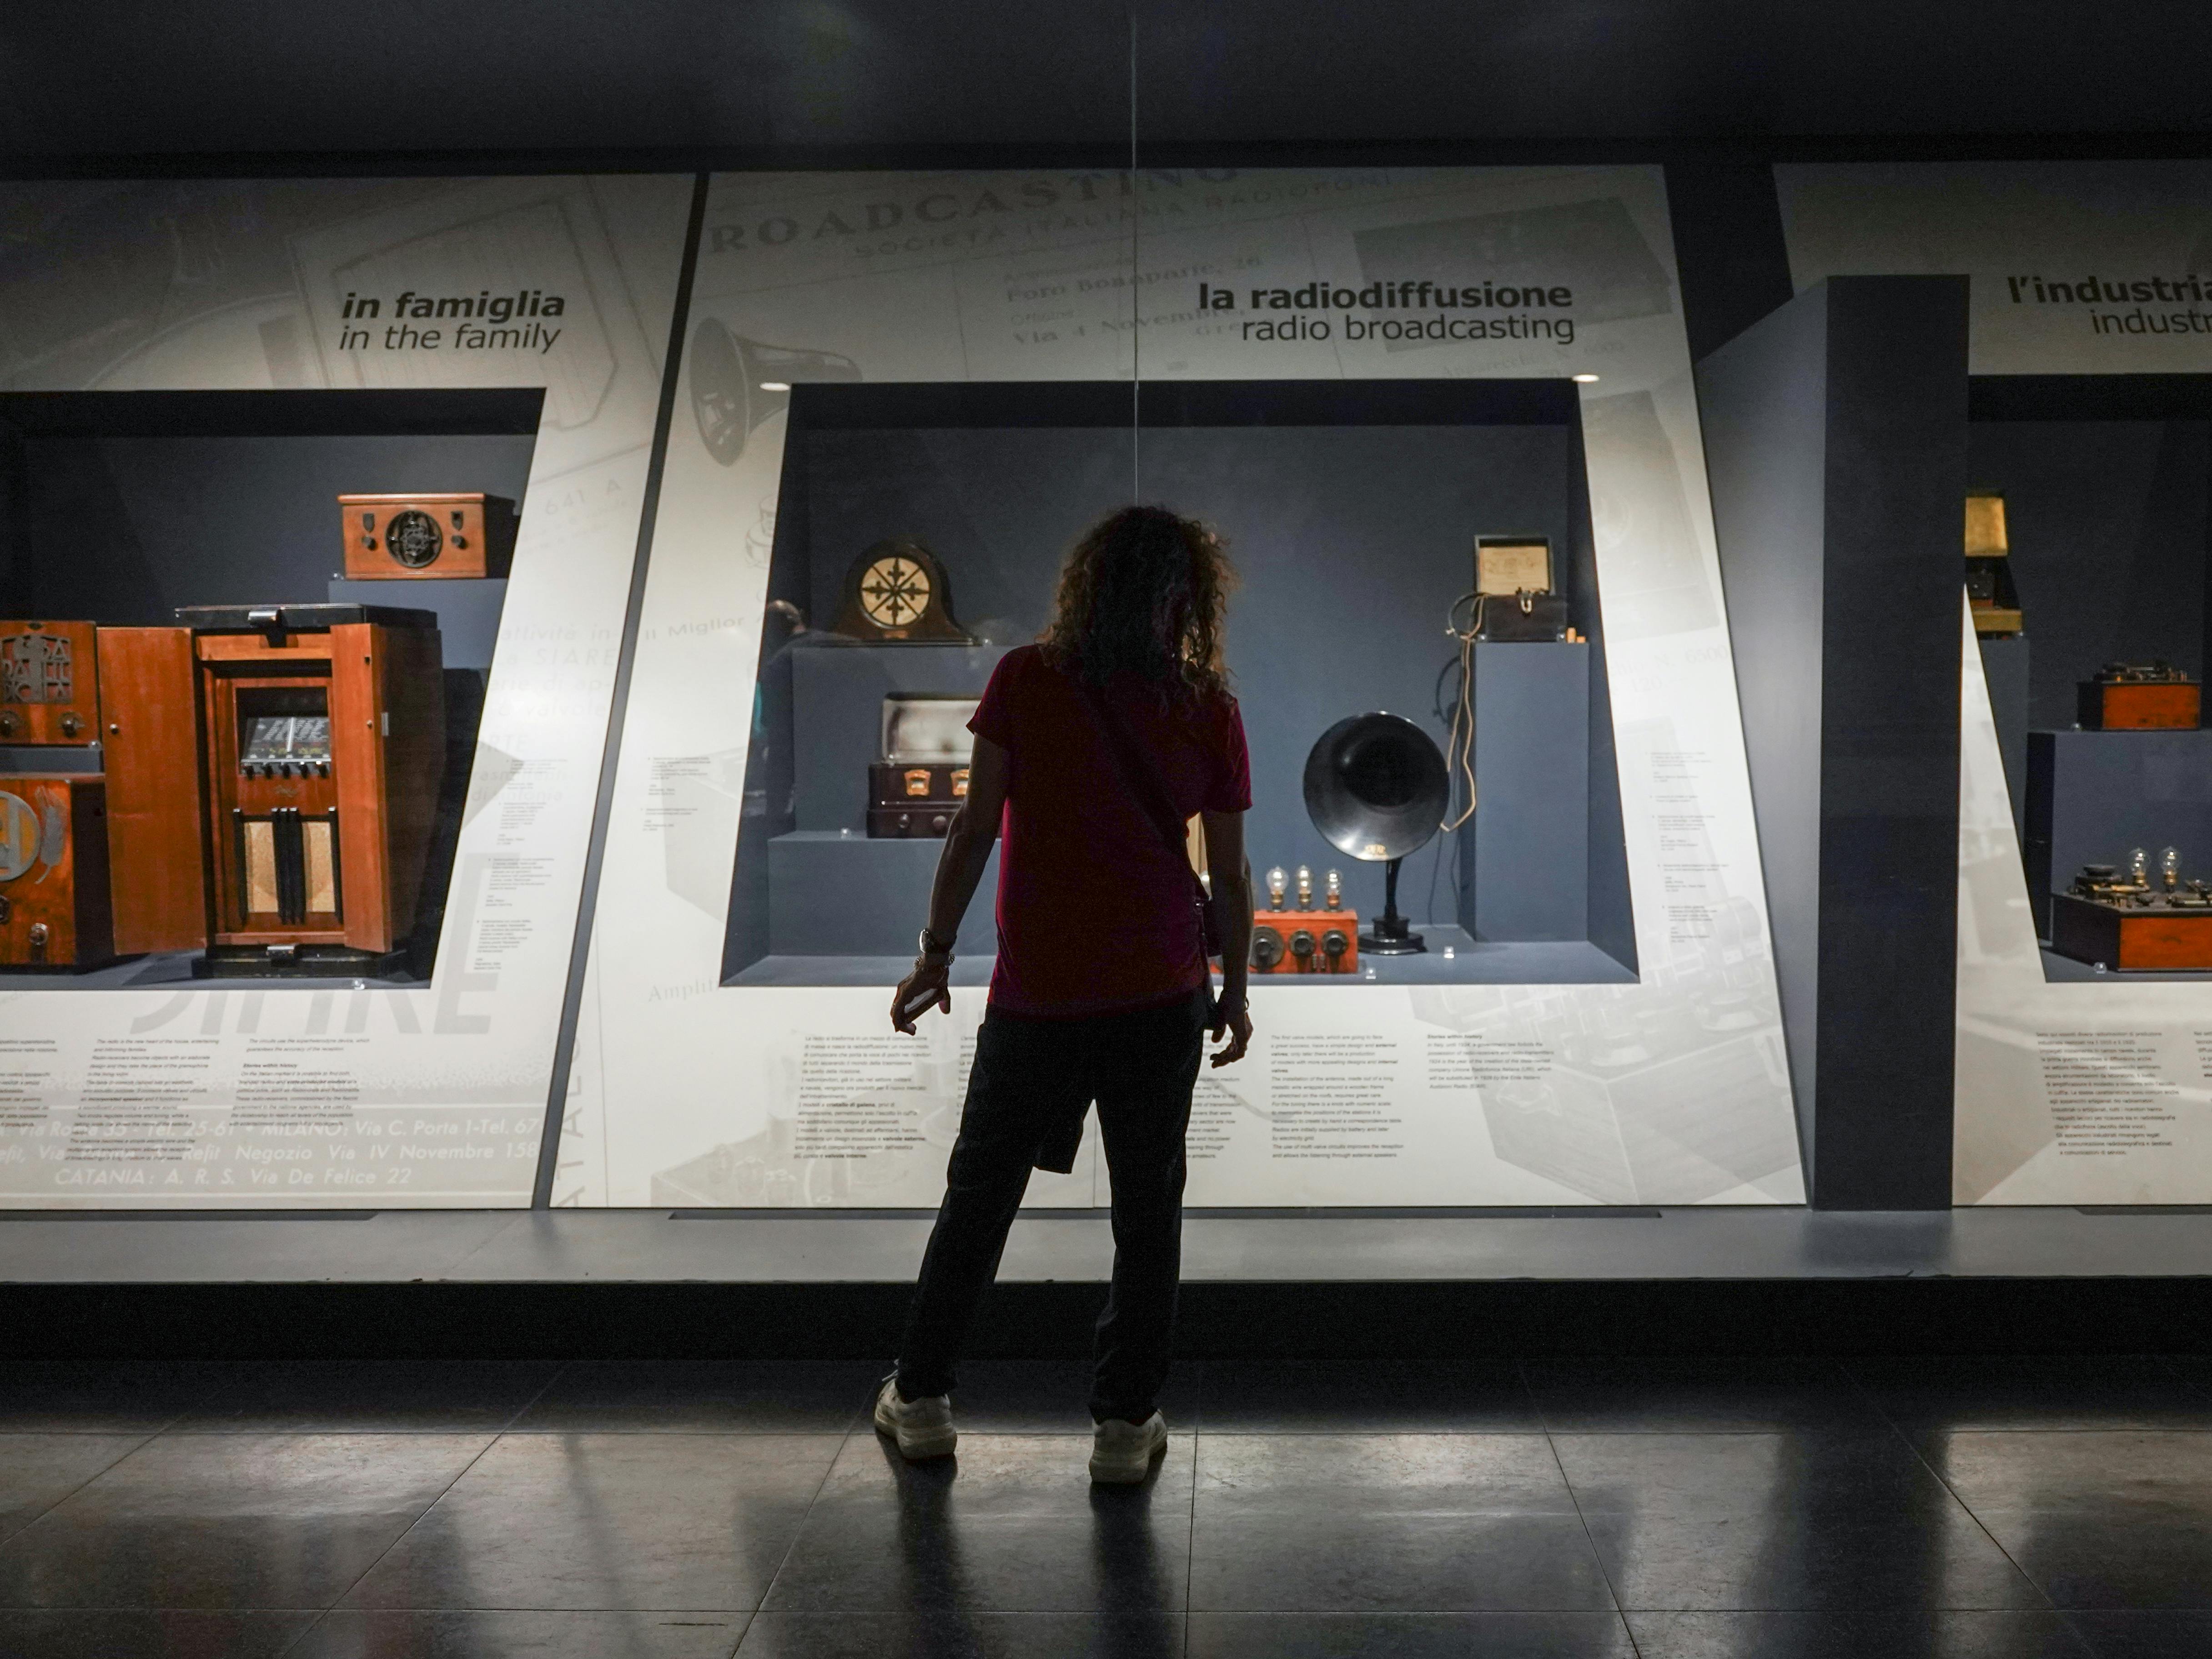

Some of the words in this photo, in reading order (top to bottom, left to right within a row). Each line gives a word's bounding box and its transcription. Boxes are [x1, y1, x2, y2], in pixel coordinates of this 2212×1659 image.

[342, 292, 380, 319] in
[395, 289, 565, 327] famiglia
[1200, 282, 1235, 310] la
[1251, 280, 1573, 309] radiodiffusione
[339, 324, 370, 350] in
[385, 323, 441, 350] the
[455, 320, 562, 354] family
[1242, 315, 1331, 341] radio
[1345, 313, 1575, 345] broadcasting
[19, 1123, 45, 1136] Via
[356, 1121, 382, 1136] Via
[388, 1119, 407, 1135] C.
[413, 1120, 458, 1135] Porta
[39, 1145, 65, 1161] Via
[235, 1144, 312, 1165] Negozio
[328, 1145, 356, 1160] Via
[369, 1145, 391, 1160] IV
[399, 1142, 495, 1159] Novembre
[55, 1167, 154, 1185] CATANIA:
[165, 1167, 184, 1185] A.
[195, 1167, 210, 1185] R.
[221, 1167, 235, 1185] S.
[251, 1168, 278, 1185] Via
[287, 1167, 314, 1185] De
[323, 1168, 377, 1185] Felice
[386, 1167, 412, 1184] 22
